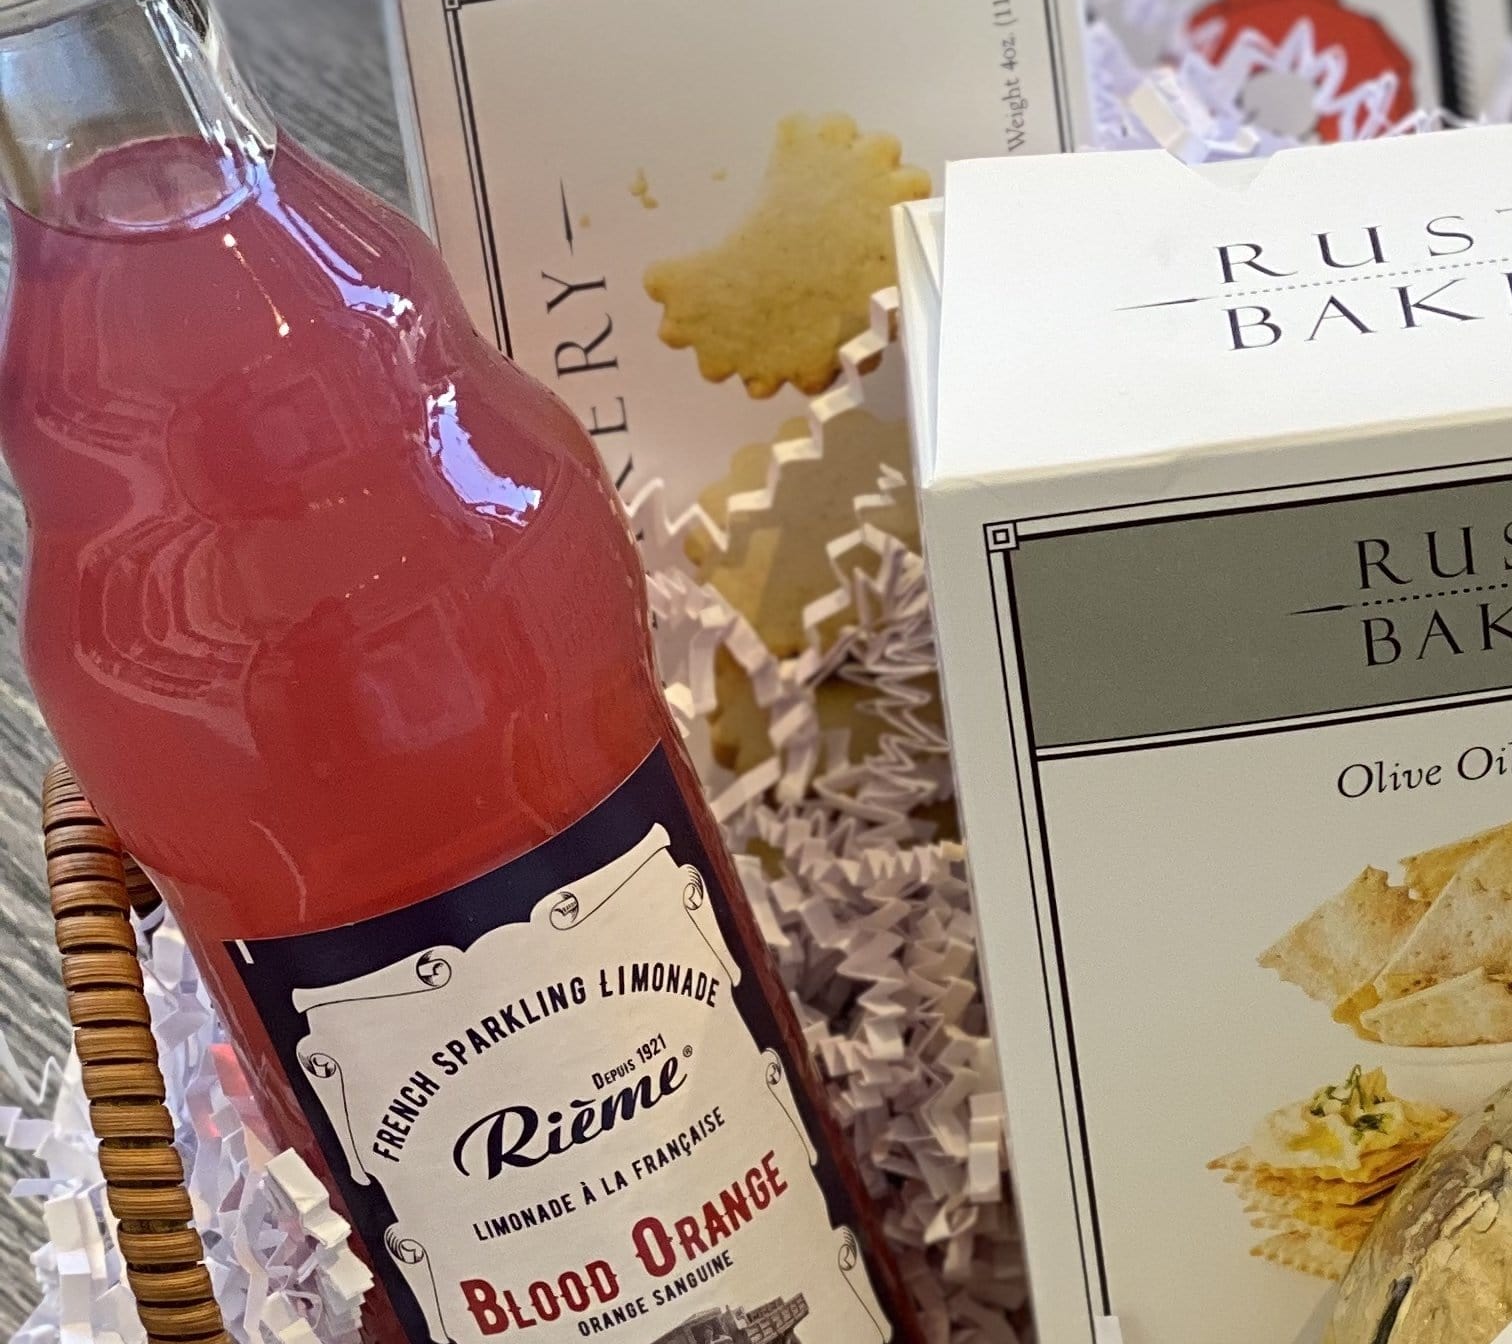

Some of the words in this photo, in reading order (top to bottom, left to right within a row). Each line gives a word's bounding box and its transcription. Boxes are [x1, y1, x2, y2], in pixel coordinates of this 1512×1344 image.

[1002, 76, 1029, 152] Weight
[1337, 758, 1443, 800] Olive
[373, 1070, 440, 1163] FRENCH
[432, 977, 586, 1076] SPARKLING
[599, 962, 720, 1008] LIMONADE
[636, 1033, 668, 1064] 1921
[473, 1193, 576, 1241] LIMONADE
[601, 1170, 628, 1196] LA
[632, 1106, 725, 1180] FRANÇAISE
[460, 1260, 620, 1336] BLOOD
[631, 1150, 788, 1278] ORANGE
[578, 1296, 649, 1338] ORANGE
[653, 1249, 734, 1306] SANGUINE
